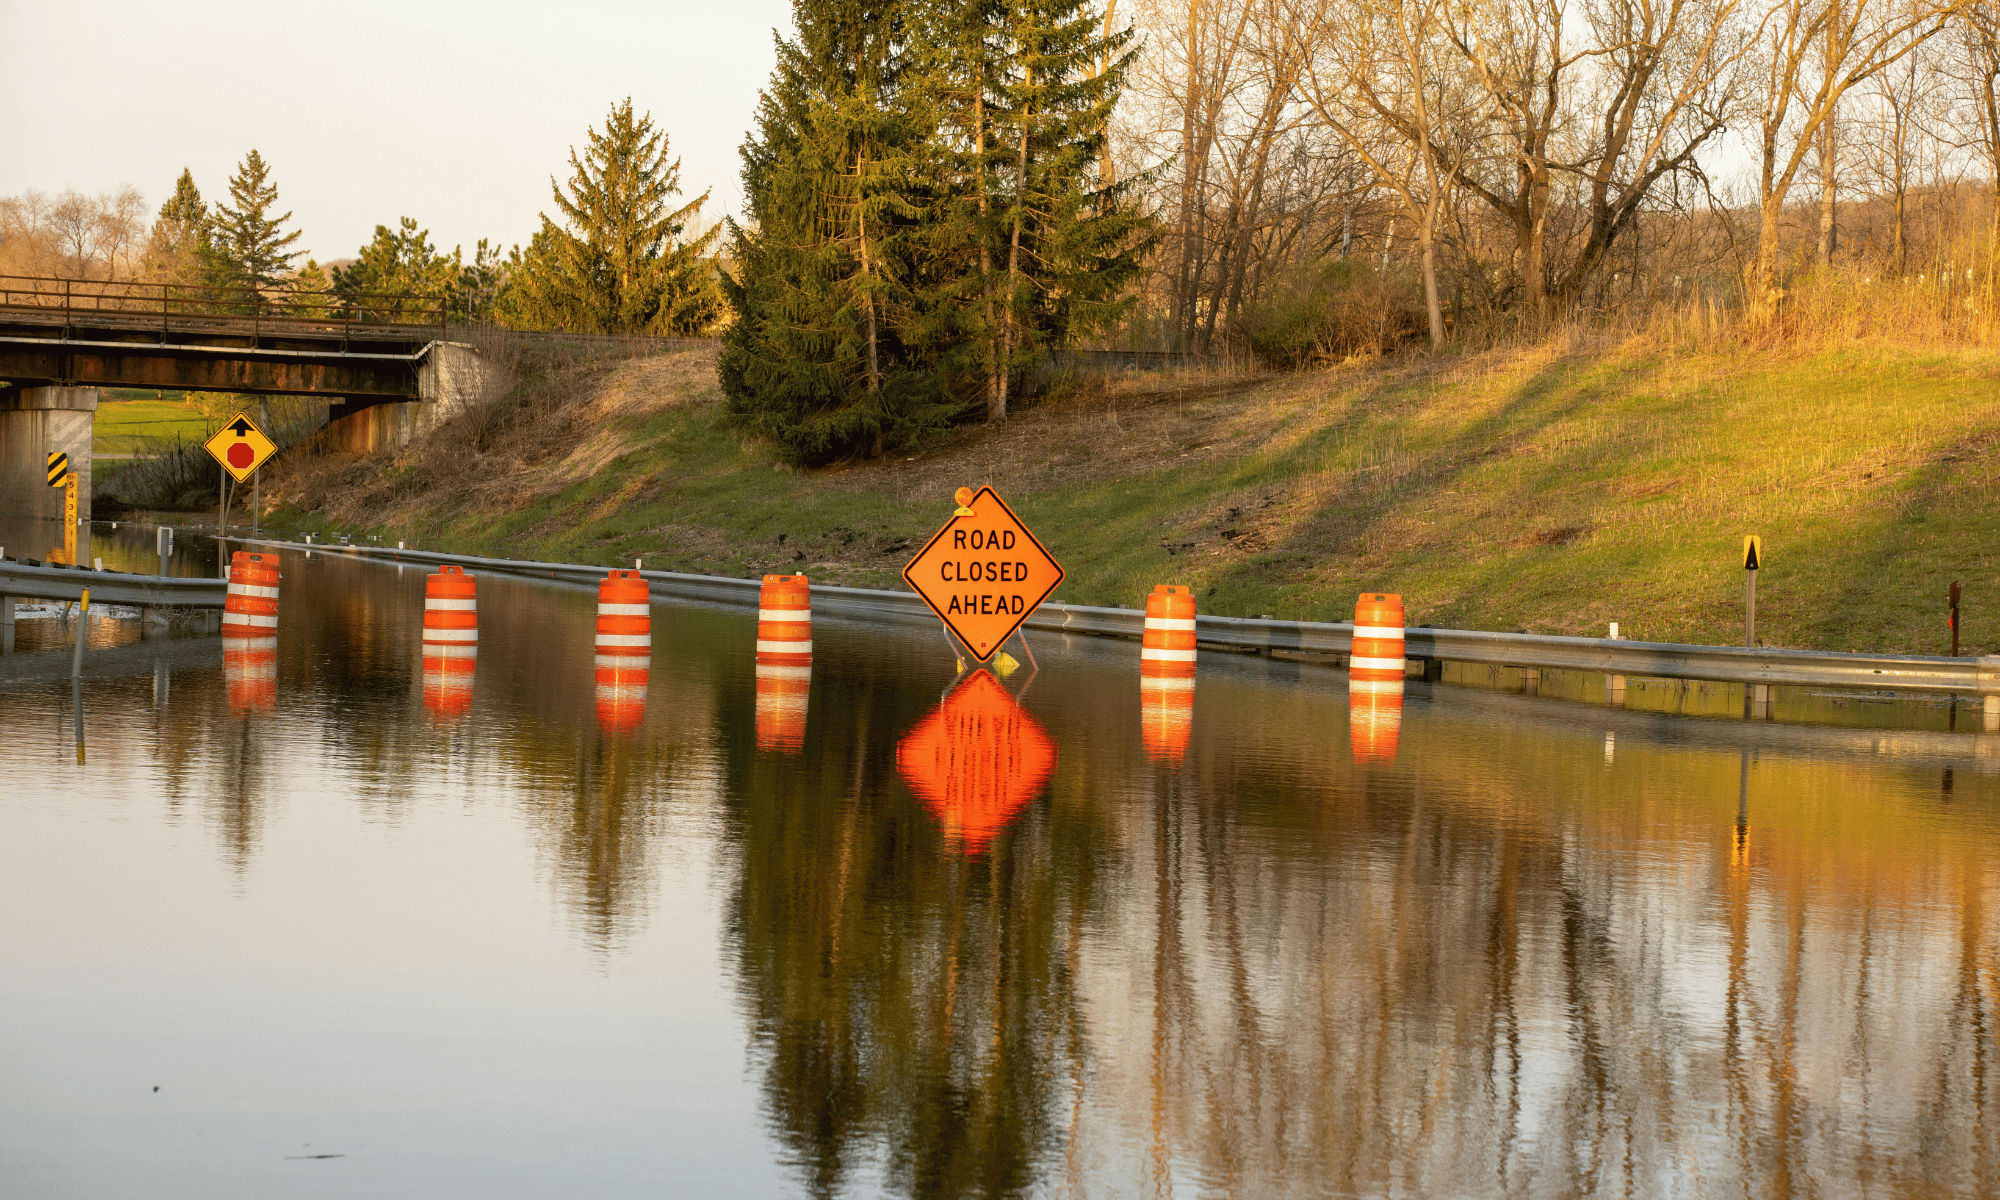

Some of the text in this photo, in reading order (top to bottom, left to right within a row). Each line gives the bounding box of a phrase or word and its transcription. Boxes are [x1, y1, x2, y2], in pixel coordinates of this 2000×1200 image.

[954, 530, 1016, 550] ROAD
[941, 561, 1028, 582] CLOSED
[947, 595, 1025, 615] AHEAD
